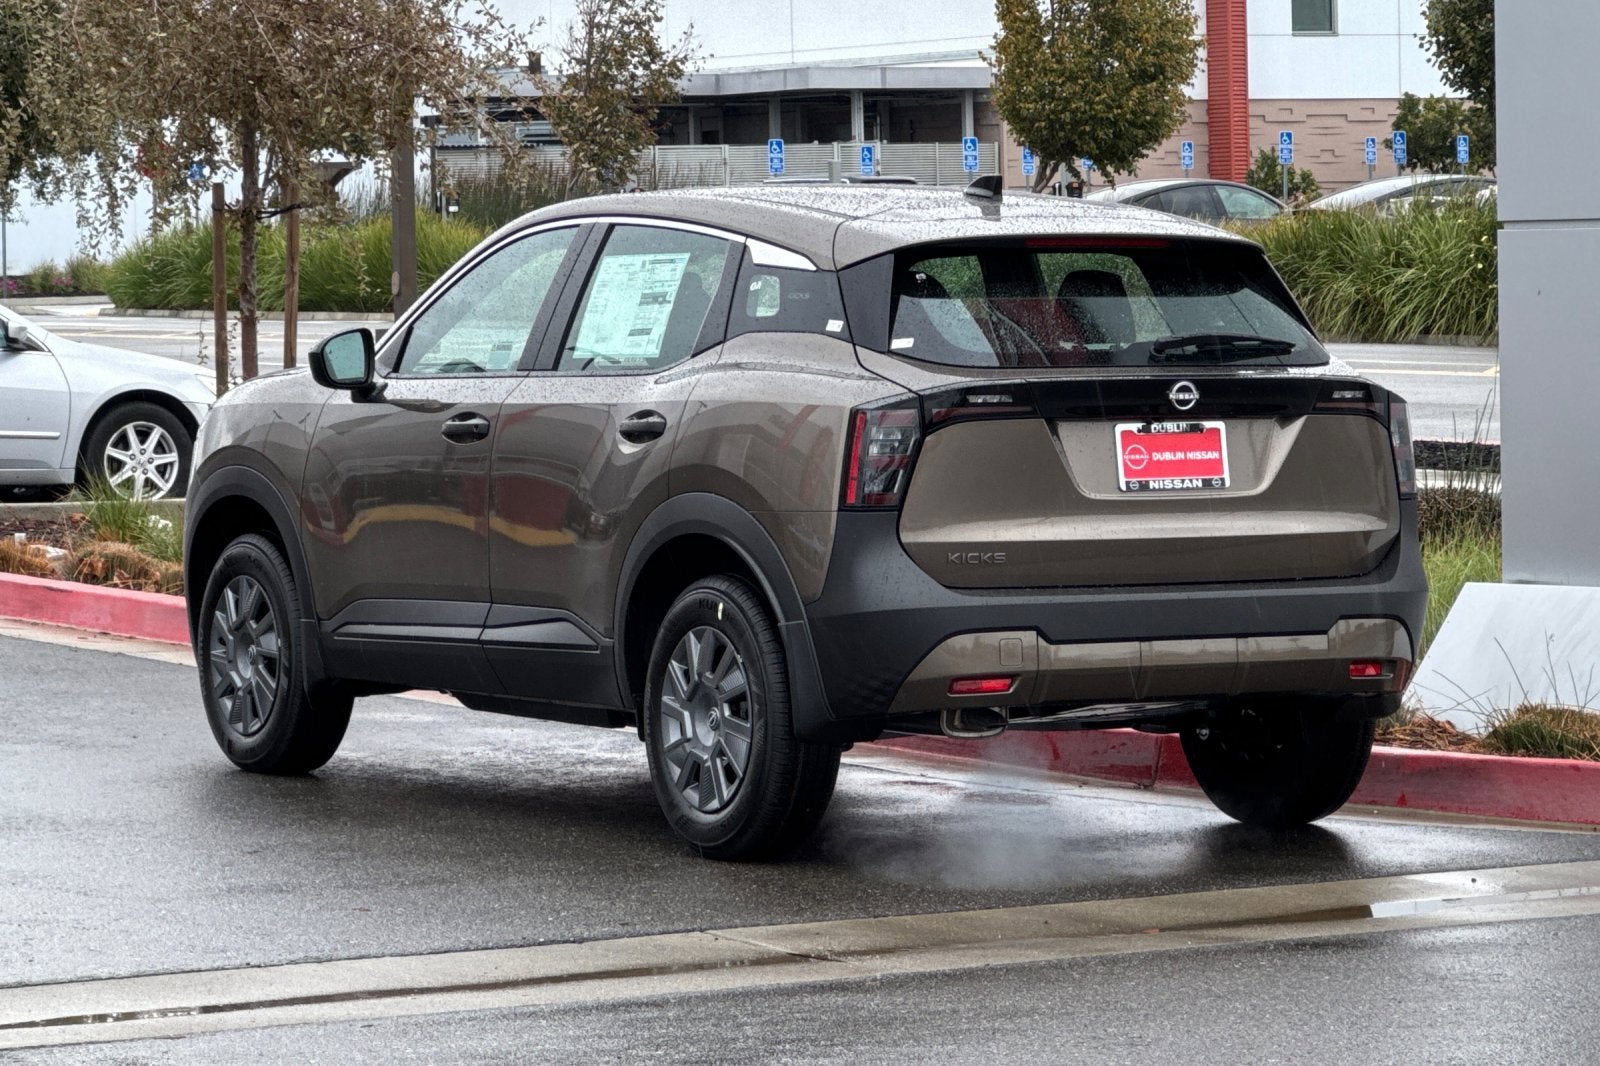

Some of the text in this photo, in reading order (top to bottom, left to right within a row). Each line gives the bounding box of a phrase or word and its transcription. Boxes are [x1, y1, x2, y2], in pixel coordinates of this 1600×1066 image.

[1169, 392, 1200, 400] NISSAN
[1151, 422, 1191, 433] DUBLIN
[1152, 450, 1220, 461] DUBLIN NISSAN
[1149, 479, 1203, 490] NISSAN
[947, 552, 1006, 564] KICKS
